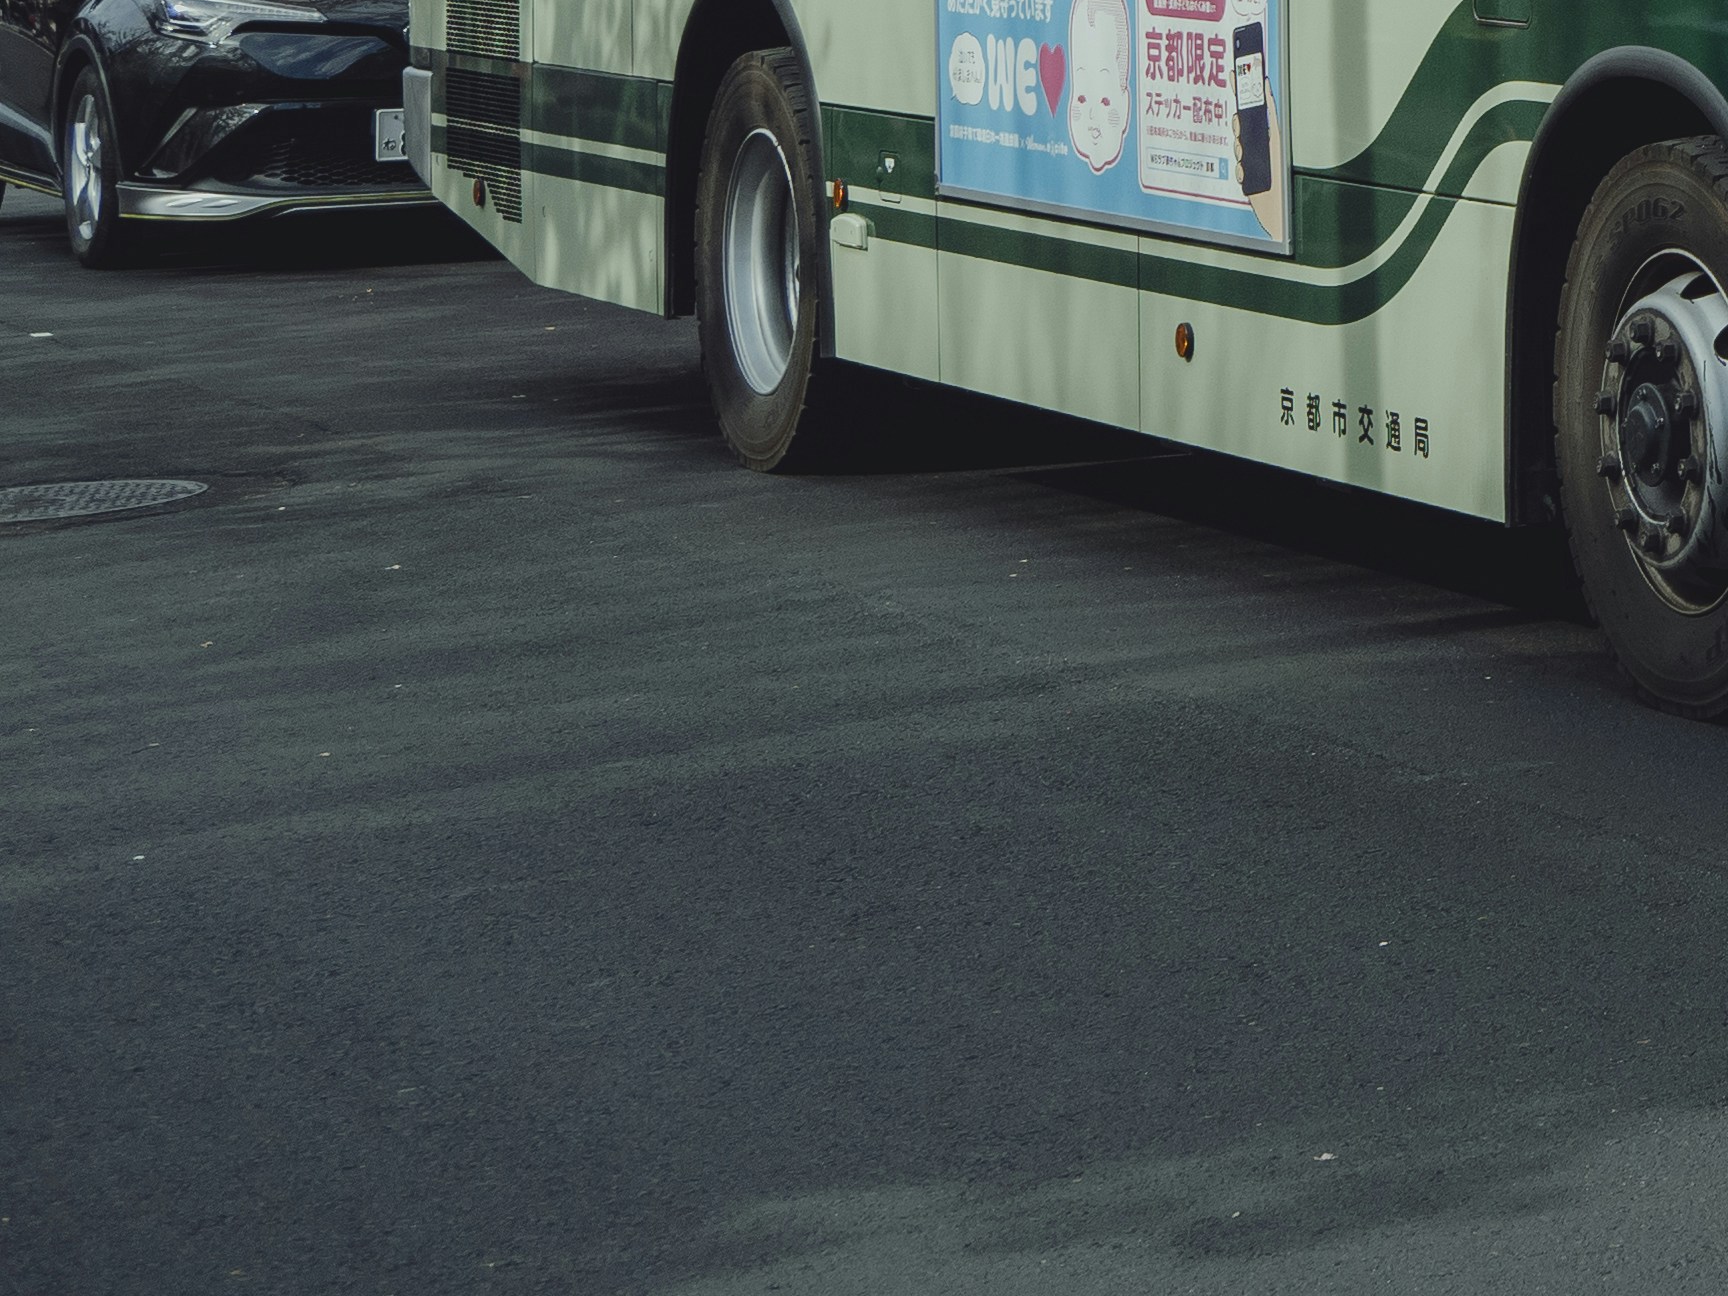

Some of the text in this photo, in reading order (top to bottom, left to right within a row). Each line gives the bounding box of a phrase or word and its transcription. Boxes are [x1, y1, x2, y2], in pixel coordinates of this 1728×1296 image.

[986, 33, 1038, 116] WE
[1145, 26, 1227, 88] 京都限定
[1279, 387, 1430, 459] 京都市交通局
